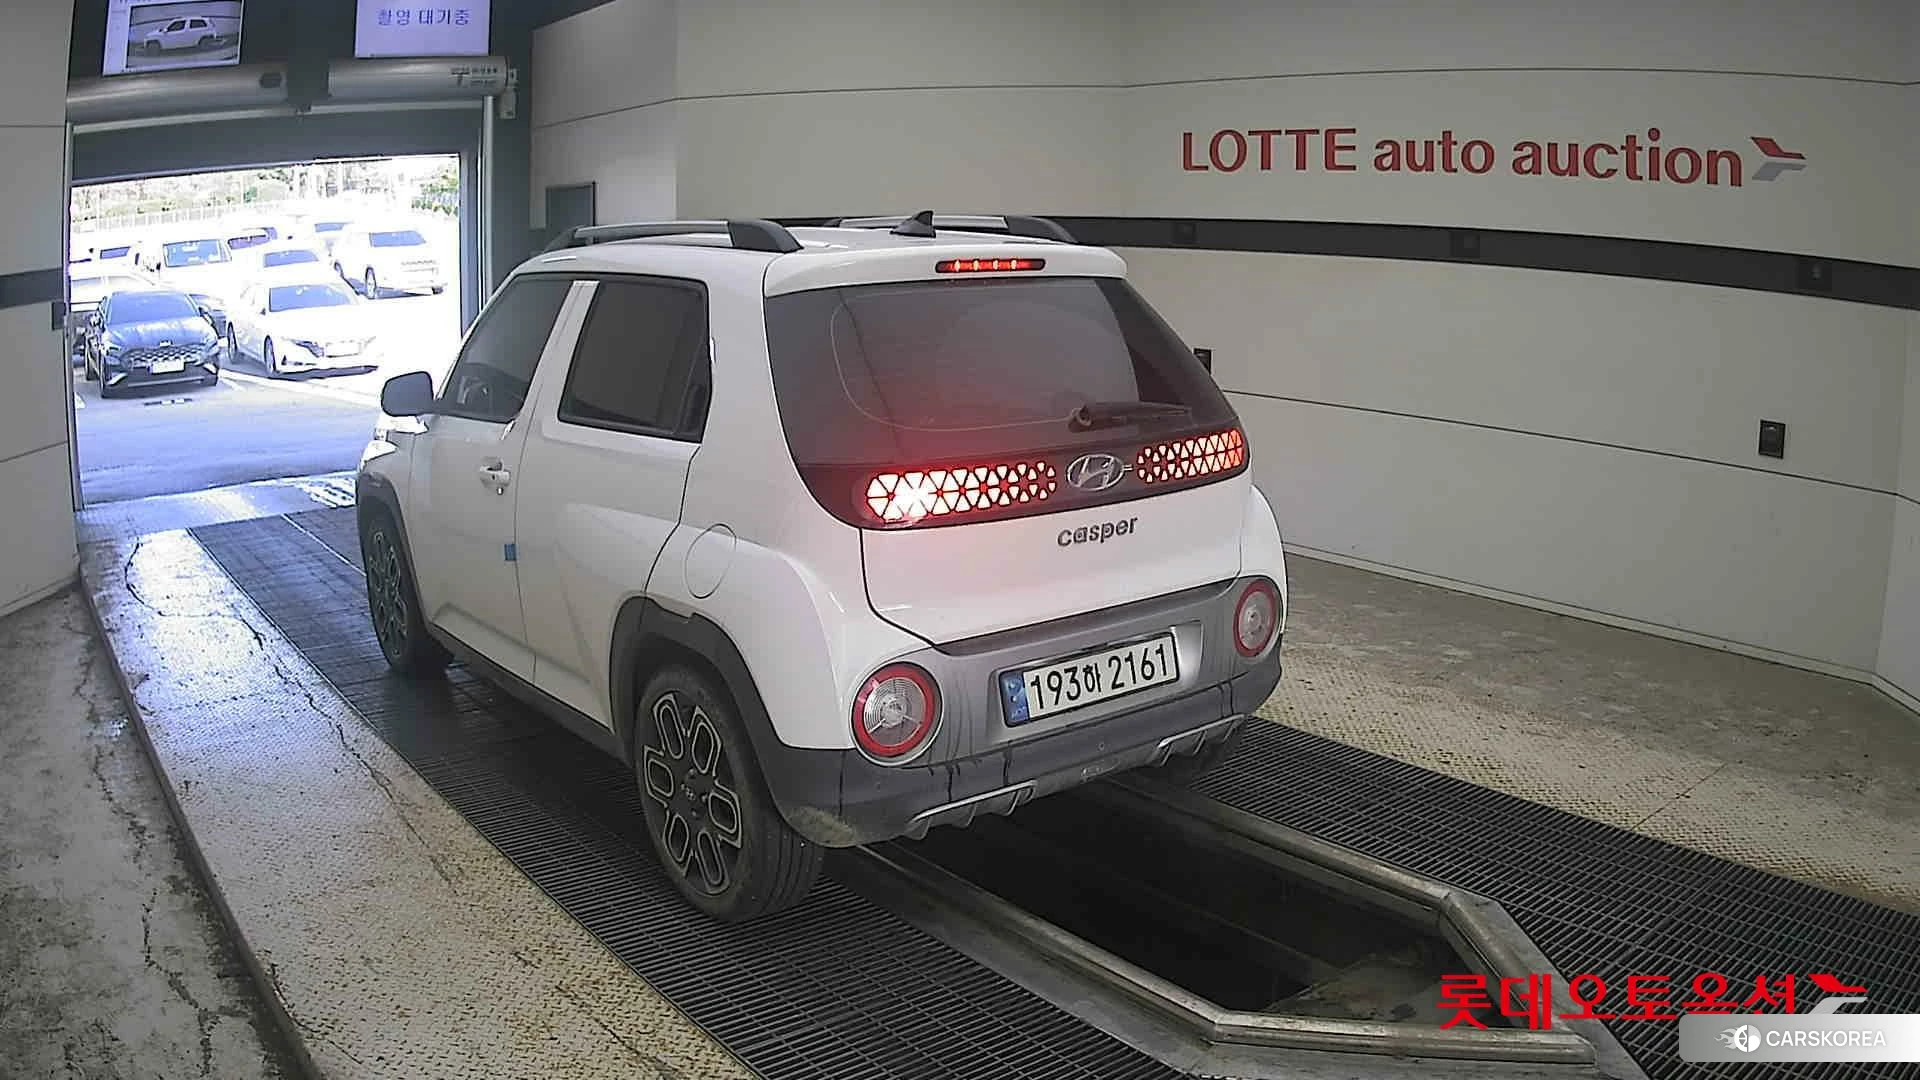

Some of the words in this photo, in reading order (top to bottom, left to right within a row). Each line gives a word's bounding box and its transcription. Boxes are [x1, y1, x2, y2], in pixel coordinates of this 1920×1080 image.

[418, 9, 471, 26] 대기중
[1183, 128, 1356, 173] LOTTE
[1373, 130, 1496, 174] auto
[1511, 127, 1743, 187] auction
[1057, 517, 1138, 547] casper
[1030, 662, 1101, 709] 193하
[1108, 643, 1167, 690] 2161
